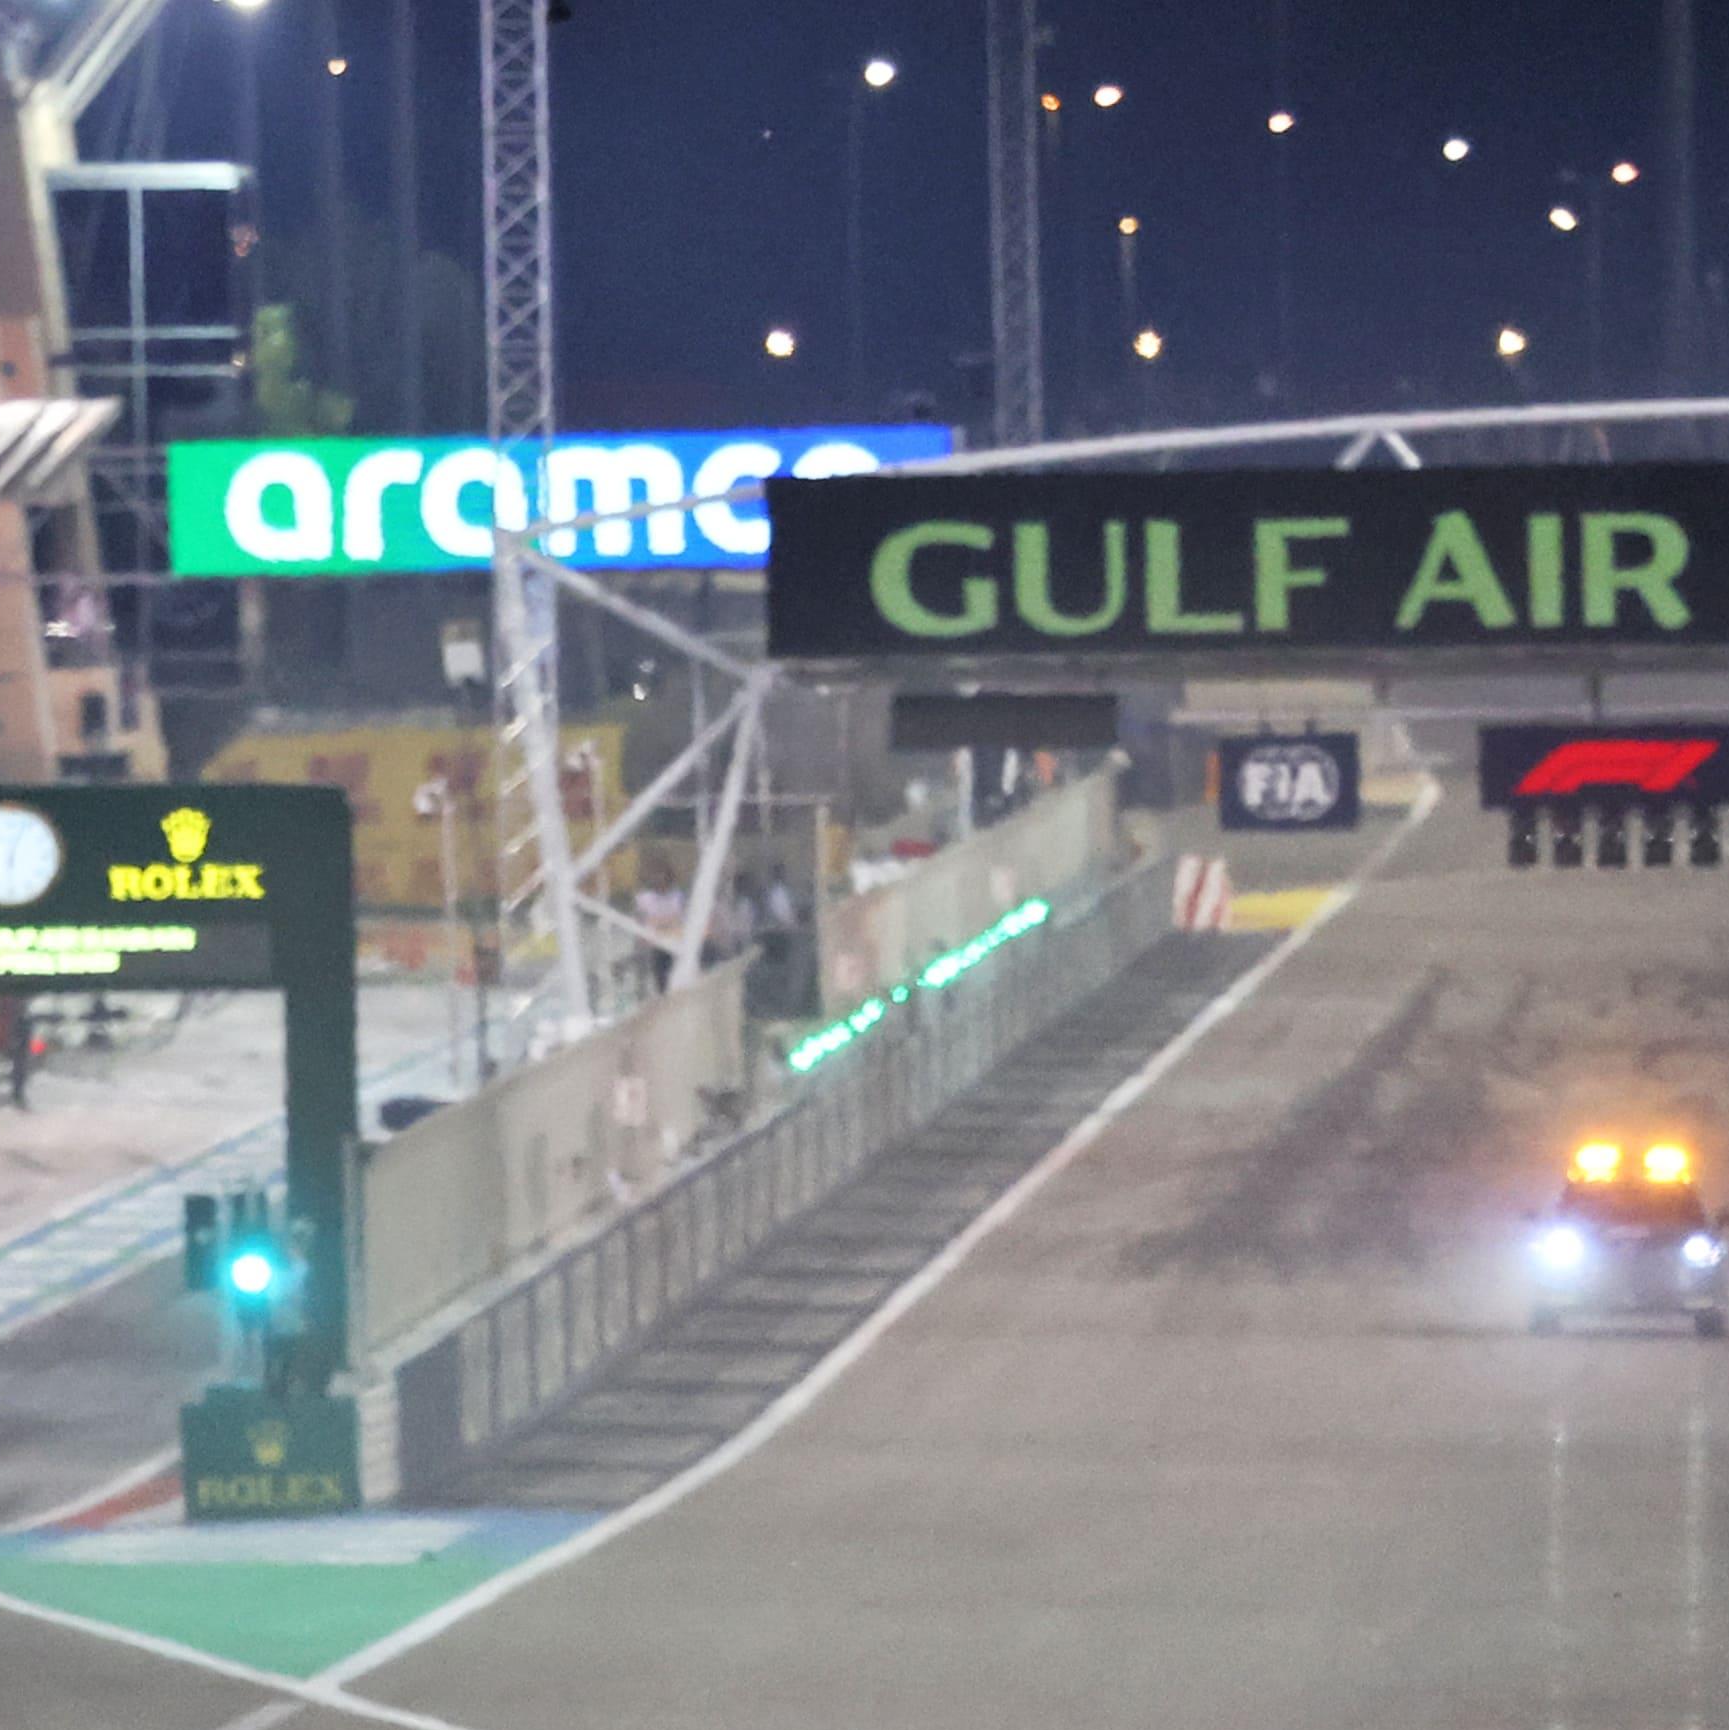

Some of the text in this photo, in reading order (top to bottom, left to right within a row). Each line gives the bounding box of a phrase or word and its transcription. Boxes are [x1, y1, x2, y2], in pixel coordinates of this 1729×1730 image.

[225, 443, 879, 563] aramc
[871, 508, 1691, 636] GULF AIR
[107, 863, 265, 901] ROLEX
[197, 1475, 344, 1504] ROLEX
